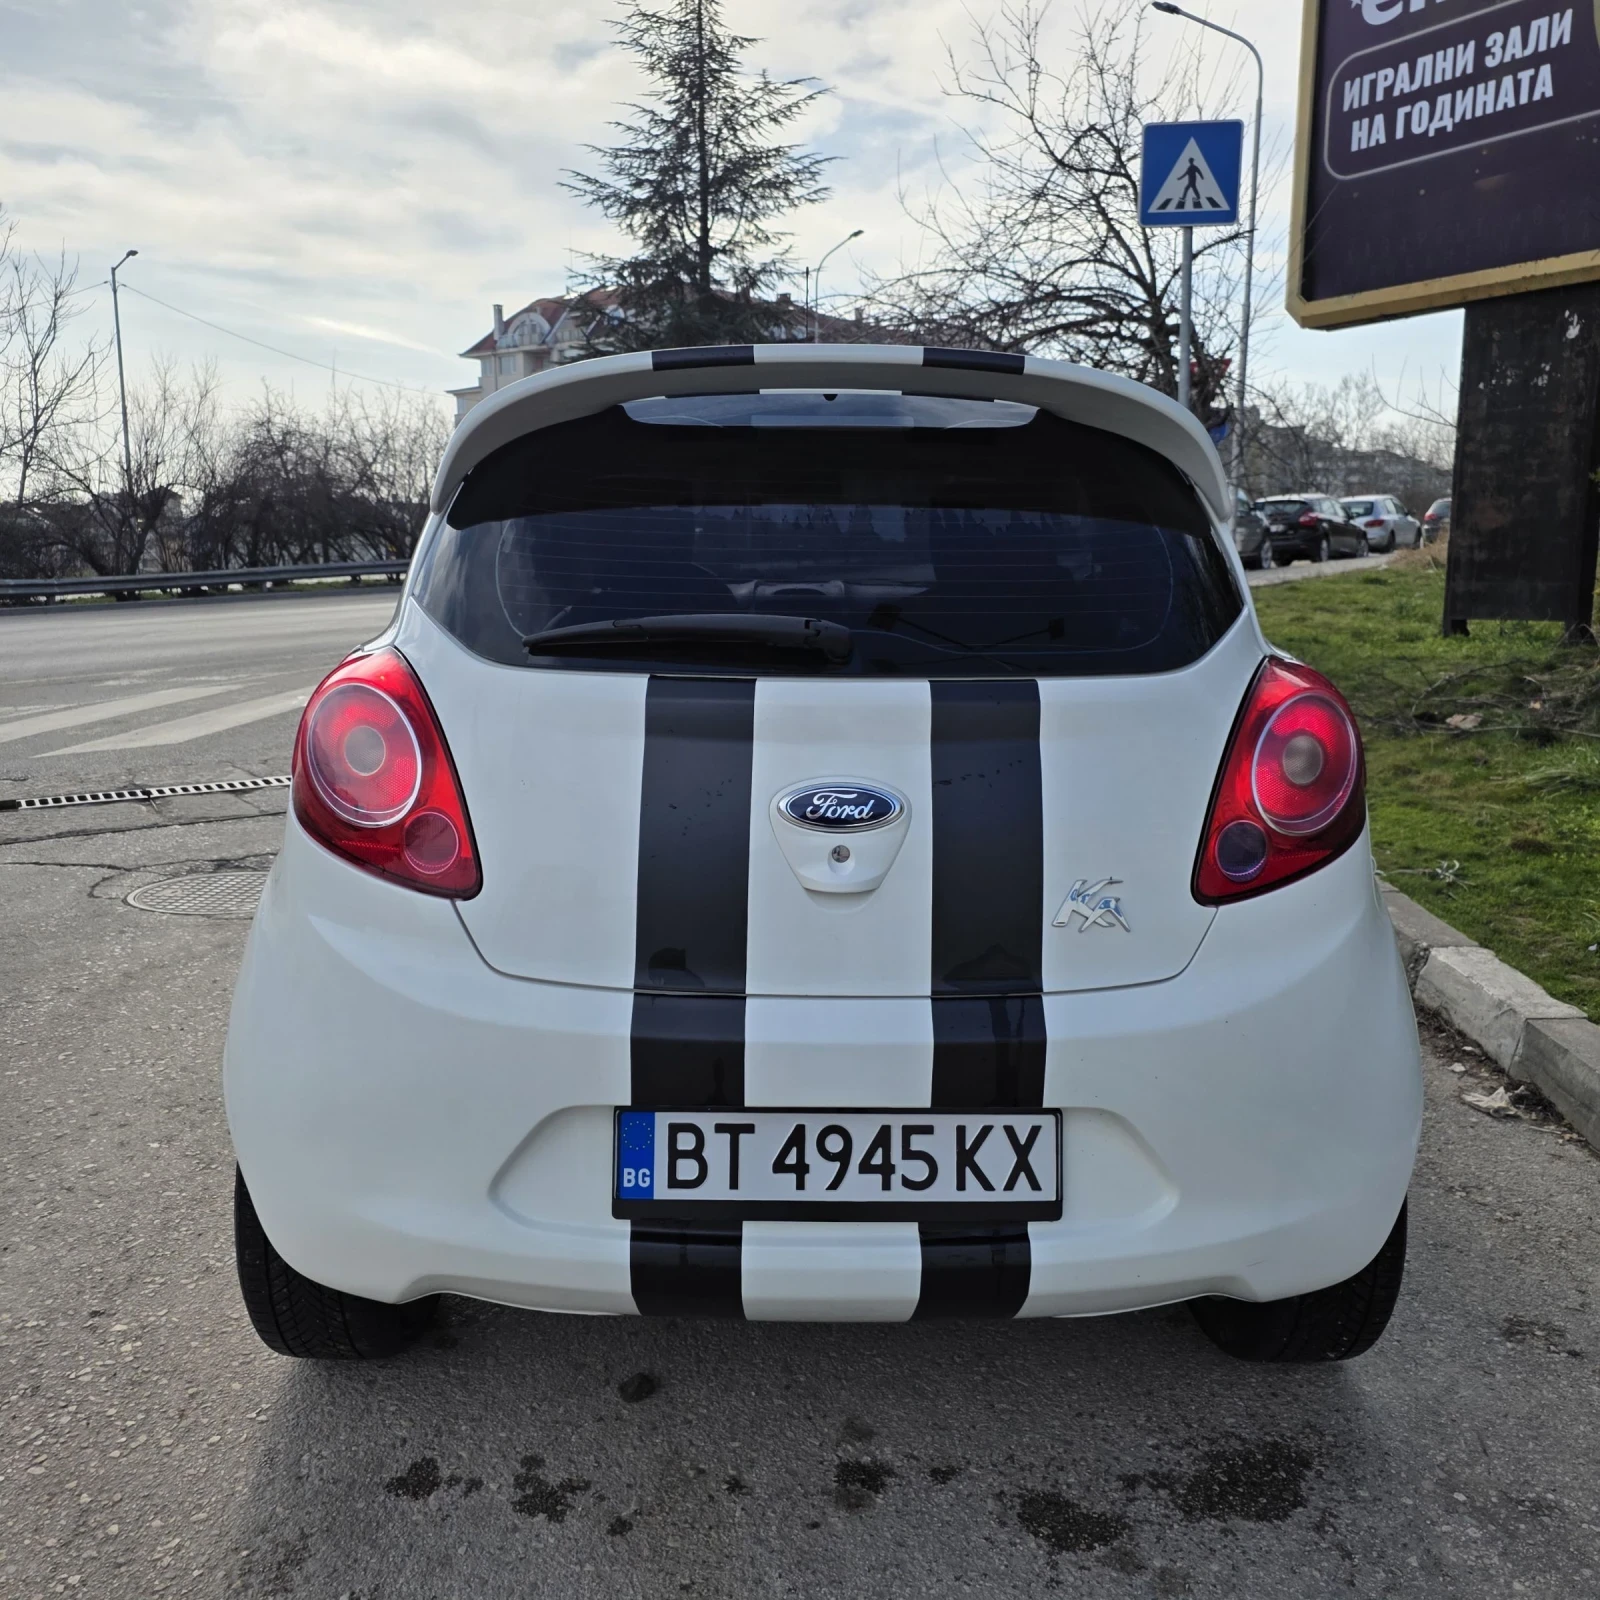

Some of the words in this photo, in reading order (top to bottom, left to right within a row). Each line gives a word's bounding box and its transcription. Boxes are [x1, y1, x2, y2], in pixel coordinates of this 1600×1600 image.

[1343, 40, 1475, 112] ИГРАЛНИ
[1485, 8, 1573, 68] ЗАЛИ
[1351, 113, 1386, 152] НА
[1395, 63, 1554, 139] ГОДИНАТА
[806, 792, 875, 820] Ford
[623, 1167, 651, 1188] BG
[667, 1122, 756, 1190] BT
[772, 1124, 939, 1191] 4945
[956, 1125, 1043, 1192] KX
